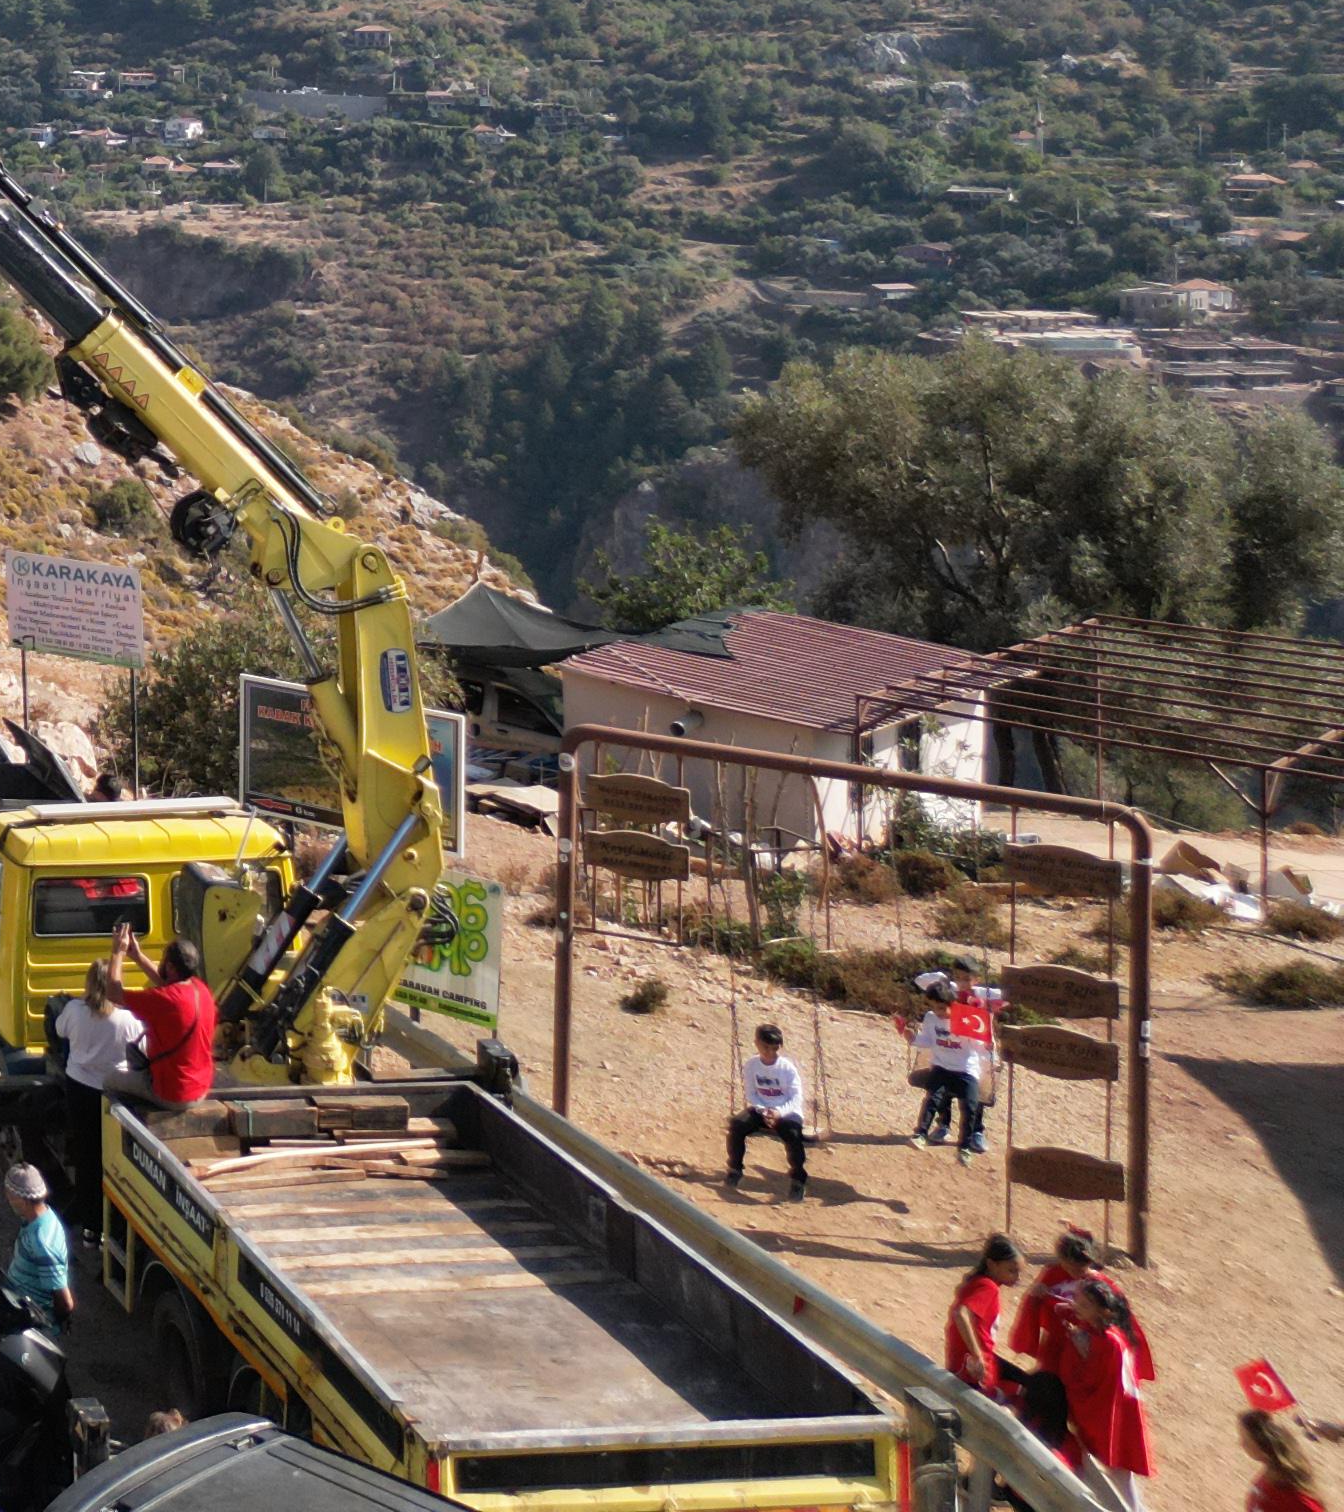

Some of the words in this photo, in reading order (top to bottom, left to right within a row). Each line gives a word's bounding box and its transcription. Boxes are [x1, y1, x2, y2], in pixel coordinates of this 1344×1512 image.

[32, 561, 136, 590] KARAKAYA
[257, 705, 302, 725] KABAK
[441, 989, 488, 1011] CAMPING
[132, 1141, 166, 1193] DUMAN
